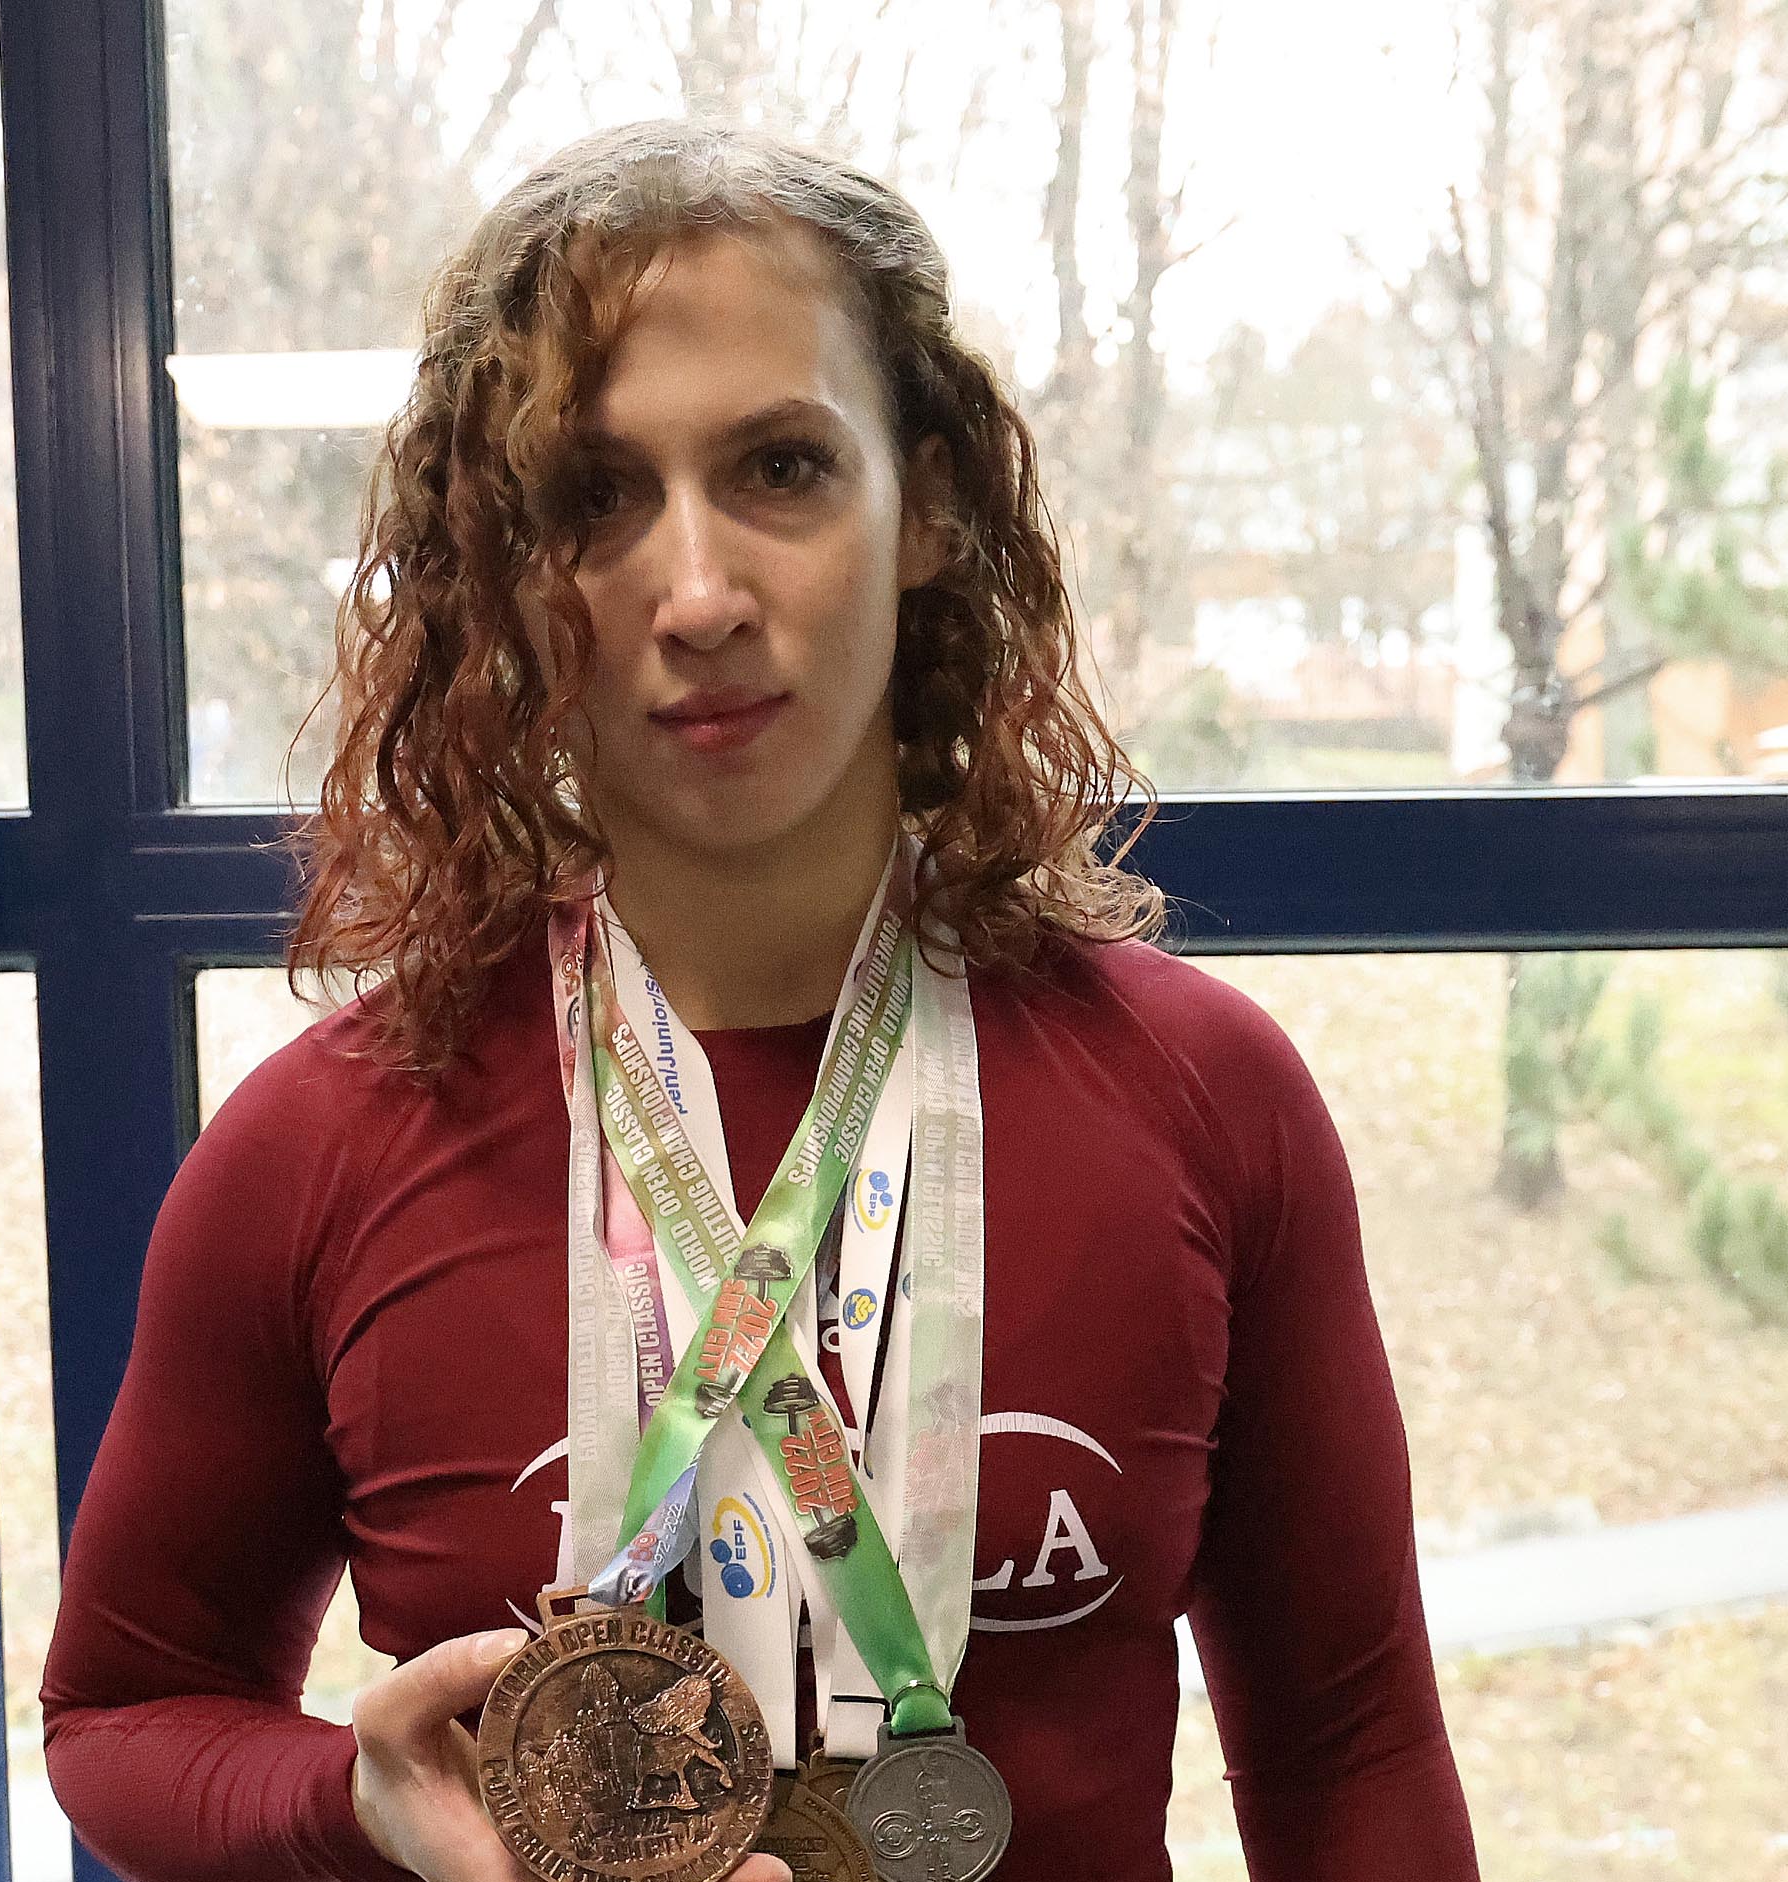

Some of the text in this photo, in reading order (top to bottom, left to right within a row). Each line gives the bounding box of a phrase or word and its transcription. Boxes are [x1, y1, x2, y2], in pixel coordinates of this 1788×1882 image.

[879, 970, 911, 1036] WORLD
[788, 910, 902, 1188] POWERLIFTING CHAMPIONSHIPS
[862, 1036, 890, 1080] OPEN
[612, 1022, 702, 1182] CHAMPIONSHIPS
[833, 1081, 880, 1164] CLASSIC
[605, 1083, 720, 1294] WORLD OPEN CLASSIC
[624, 1261, 666, 1408] OPEN CLASSIC
[696, 1279, 748, 1381] SUN CITY
[725, 1293, 778, 1374] 2022
[780, 1430, 830, 1515] 2022
[808, 1410, 859, 1516] SUN CITY
[733, 1519, 747, 1560] EPF
[559, 1619, 623, 1654] OPEN
